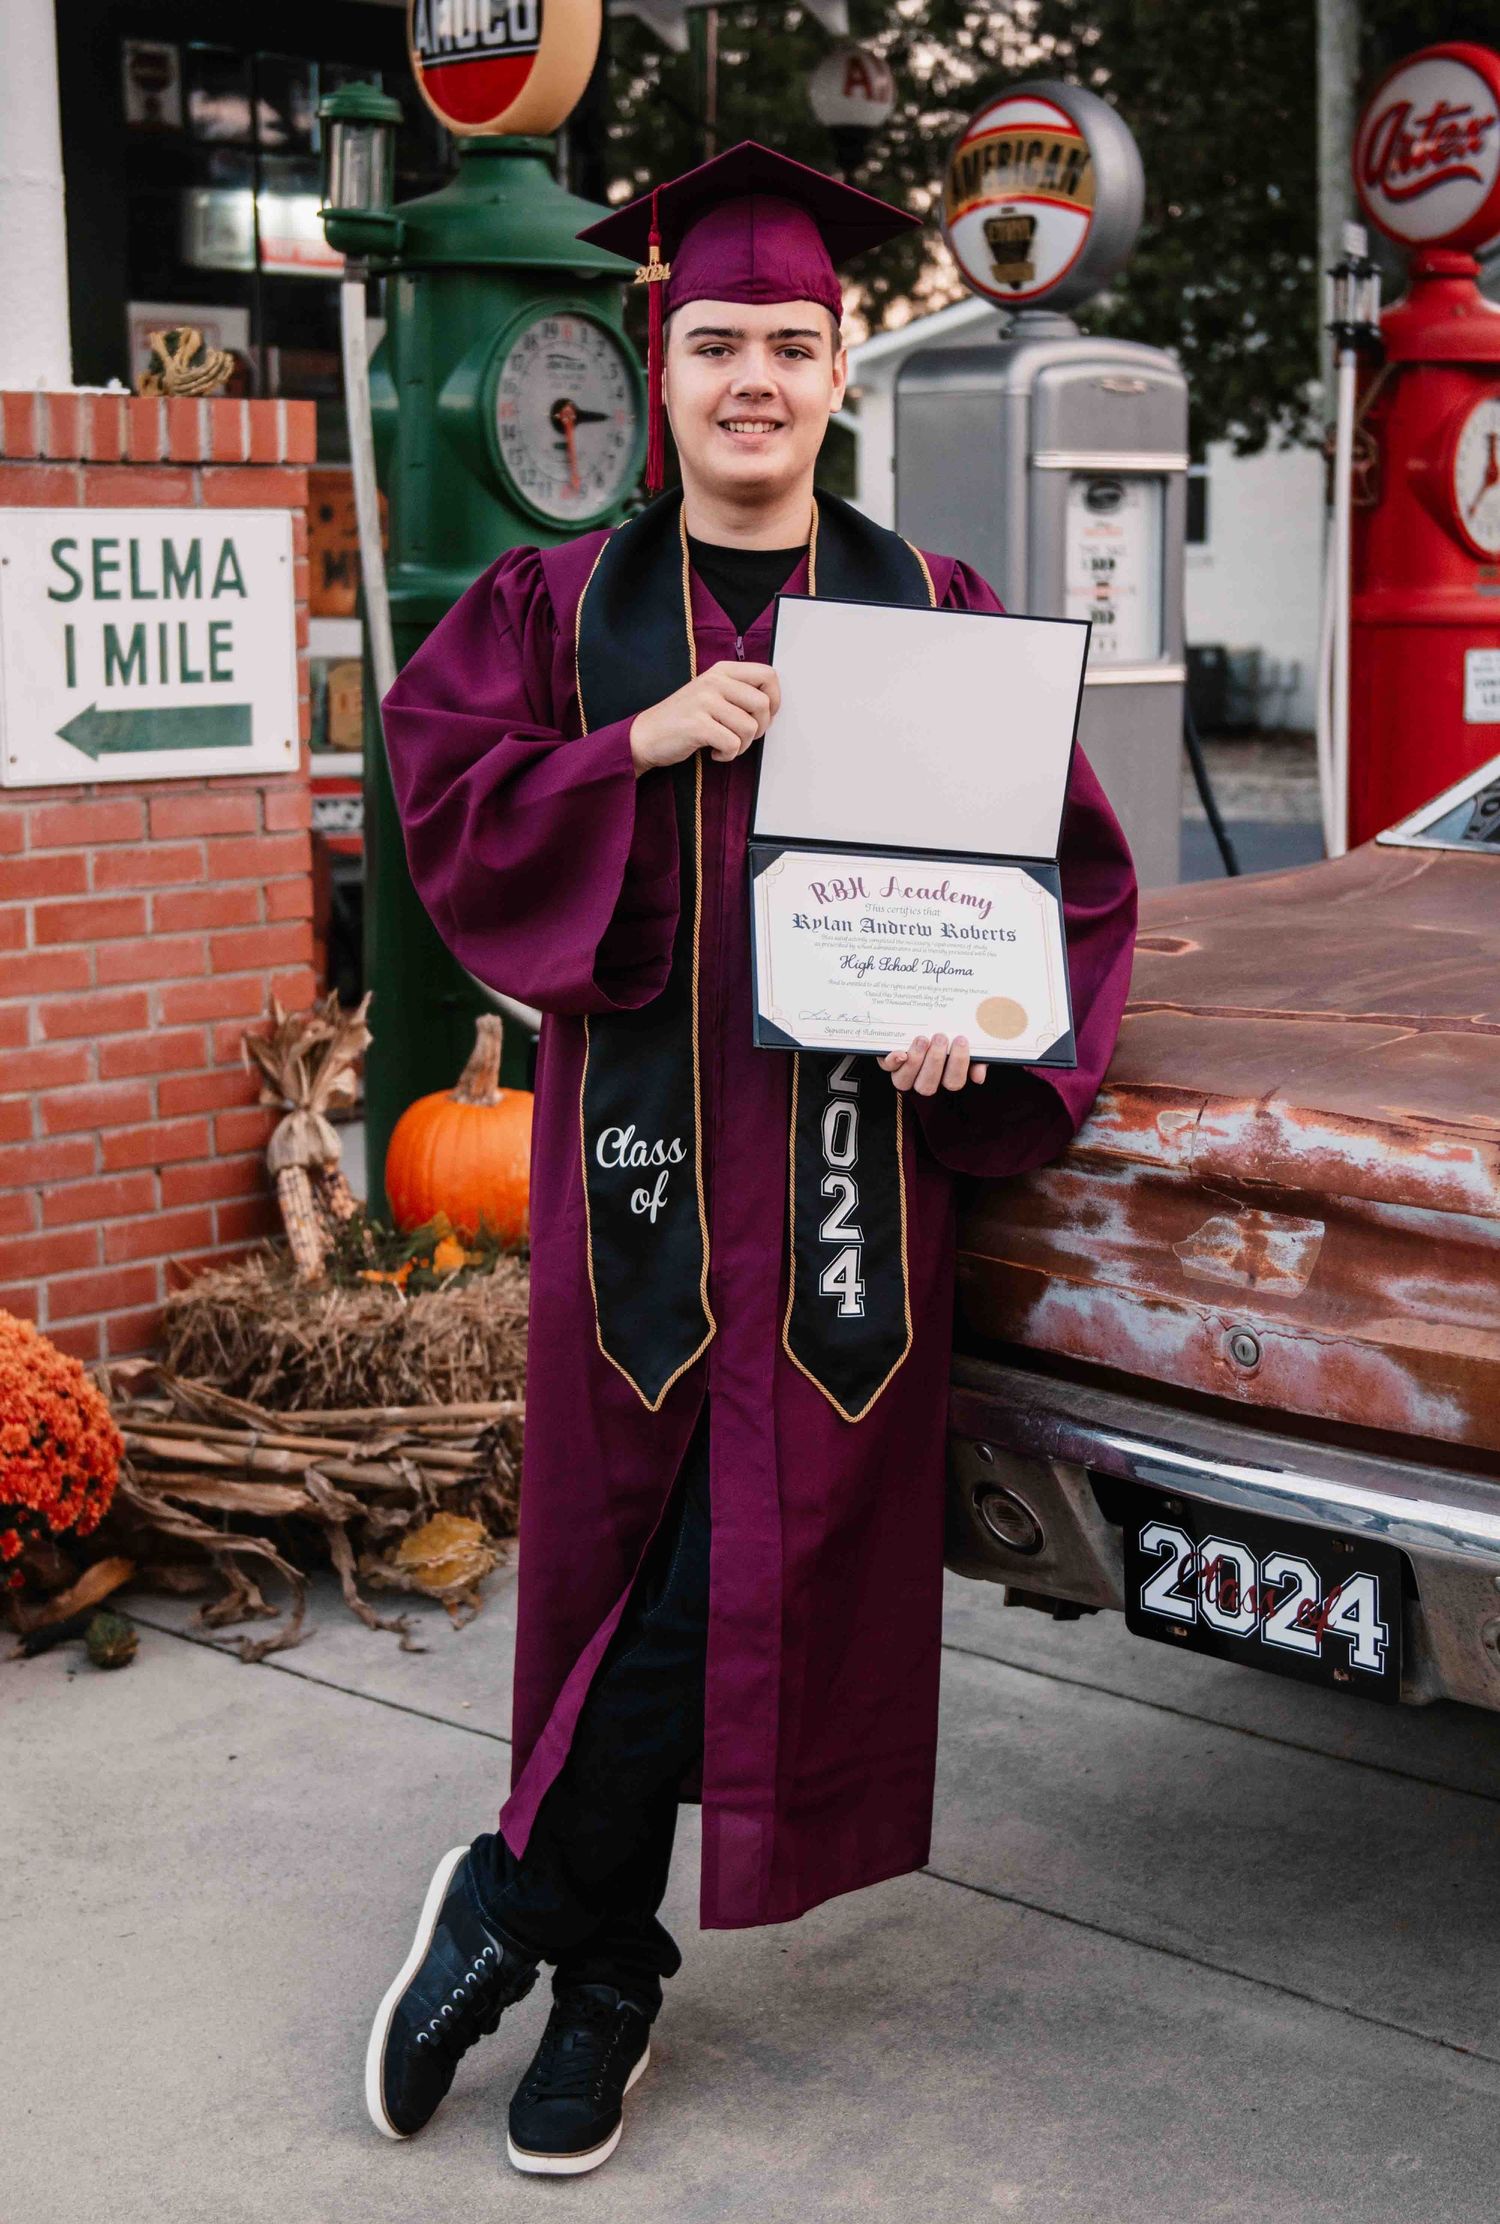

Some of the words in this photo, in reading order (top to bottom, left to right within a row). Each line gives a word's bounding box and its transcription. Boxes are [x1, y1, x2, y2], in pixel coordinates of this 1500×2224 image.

[948, 140, 1092, 206] AMERICAN
[633, 262, 671, 284] 2024
[47, 538, 247, 602] SELMA
[104, 620, 234, 687] MILE
[809, 876, 870, 904] RBH
[879, 876, 994, 920] Academy
[865, 903, 884, 913] This
[886, 906, 921, 918] certifies
[923, 908, 941, 917] that
[792, 913, 852, 933] Rylan
[860, 917, 932, 937] Andrew
[940, 922, 1017, 943] Roberts
[840, 954, 875, 979] High
[879, 956, 919, 973] School
[922, 959, 975, 983] Diploma
[595, 1124, 687, 1168] Class
[630, 1170, 669, 1224] of
[1139, 1520, 1389, 1674] 2024
[1178, 1552, 1277, 1620] Class
[1297, 1585, 1343, 1652] of
